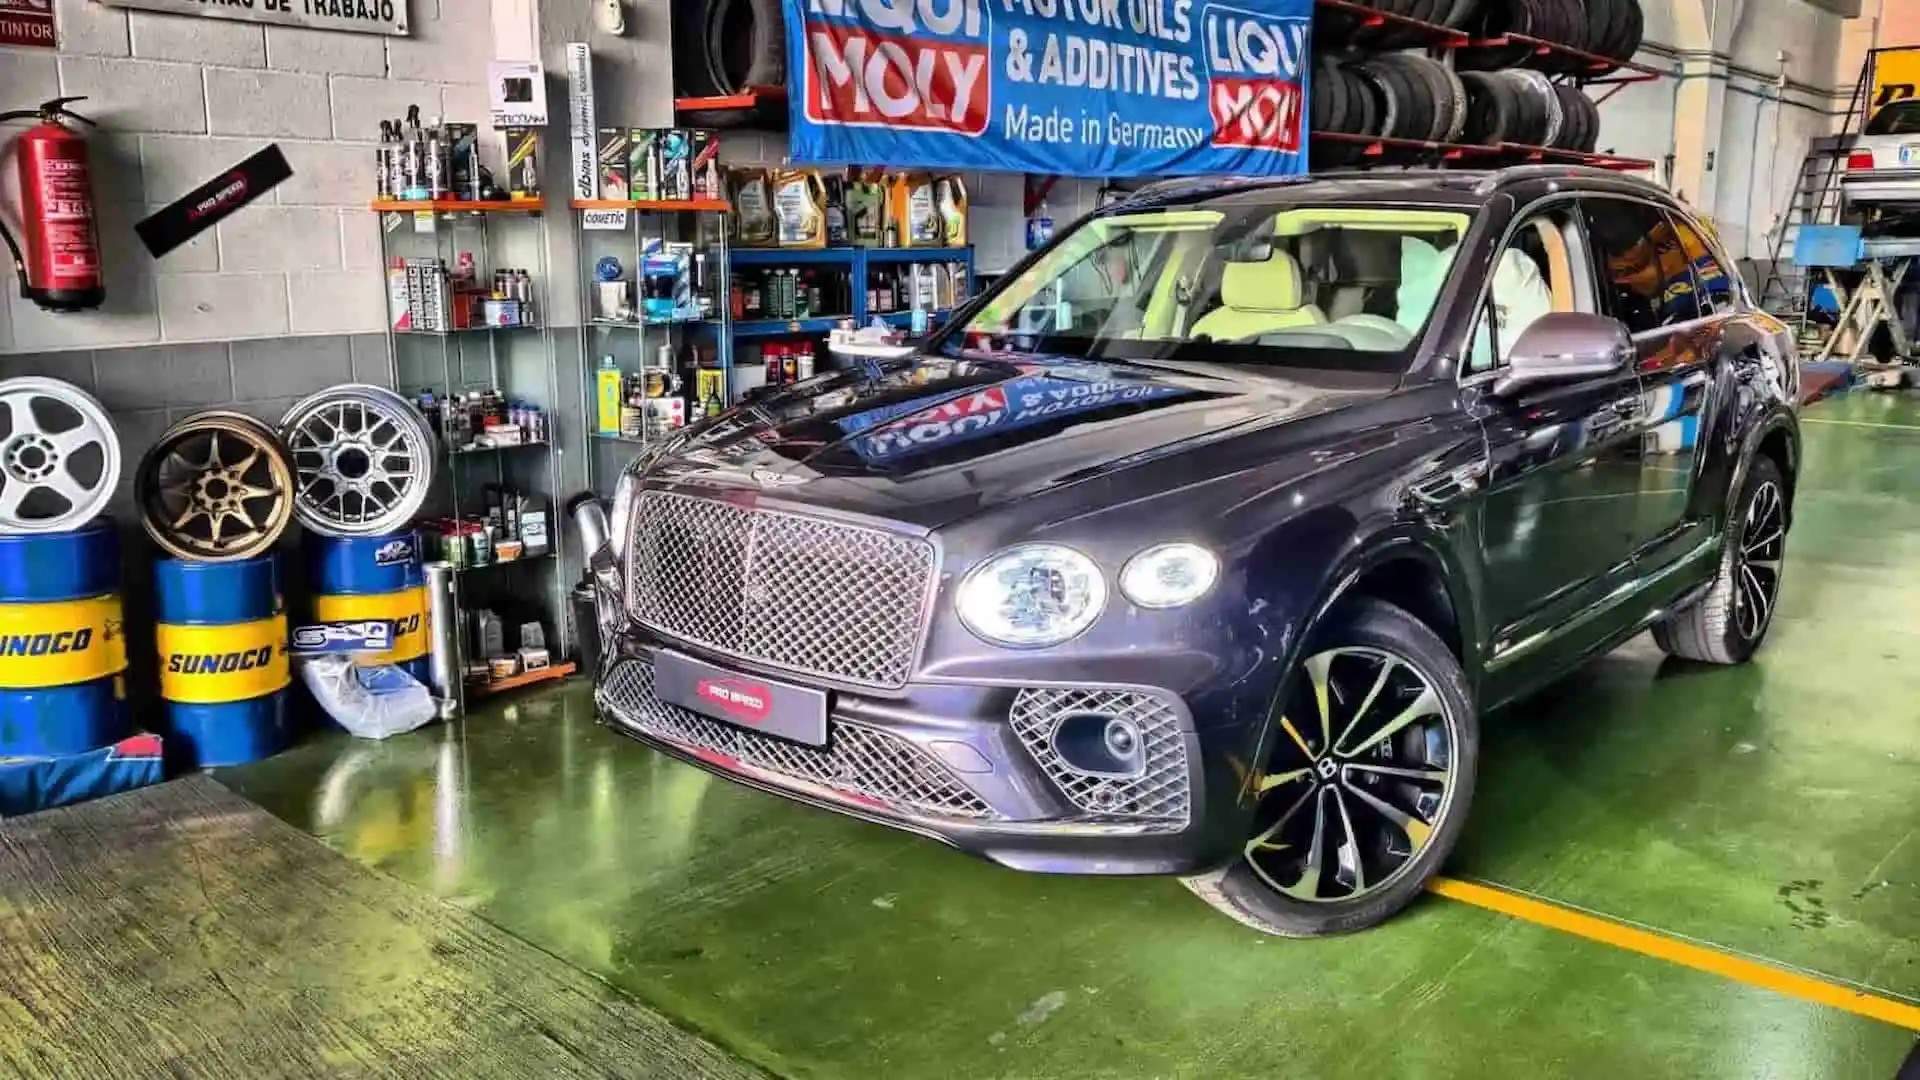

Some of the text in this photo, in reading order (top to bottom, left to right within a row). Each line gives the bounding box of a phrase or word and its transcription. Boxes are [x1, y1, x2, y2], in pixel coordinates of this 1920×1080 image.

[302, 0, 394, 21] TRABAJO
[1127, 0, 1193, 43] OILS
[1006, 28, 1200, 100] & ADDITIVES
[1208, 14, 1306, 76] LIQU
[812, 32, 985, 123] MOLY
[1005, 104, 1202, 150] Made in Germany
[1214, 83, 1300, 143] MOL
[168, 644, 273, 674] SUNOCO
